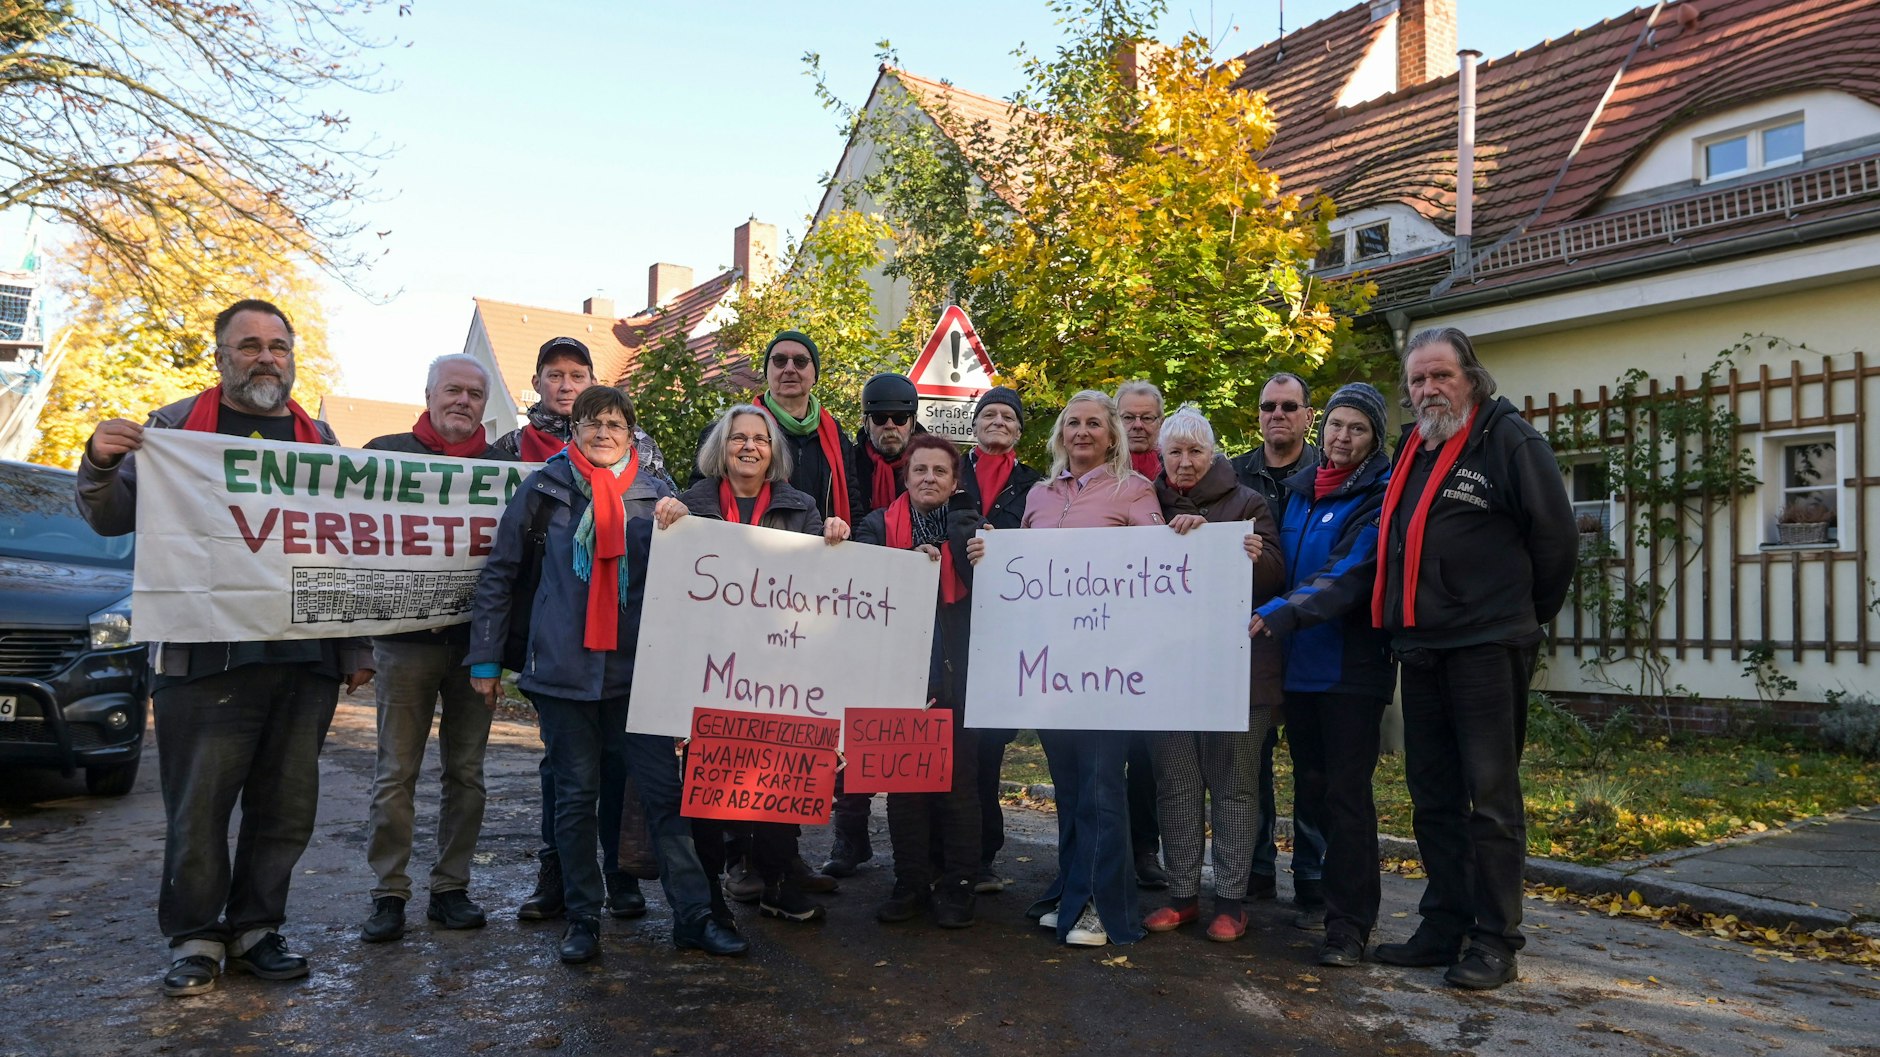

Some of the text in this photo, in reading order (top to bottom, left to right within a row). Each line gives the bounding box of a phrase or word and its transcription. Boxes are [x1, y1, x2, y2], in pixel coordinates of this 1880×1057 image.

[1457, 481, 1475, 493] AM
[687, 554, 897, 627] Solidarität
[999, 553, 1192, 602] Solidarität
[1073, 602, 1111, 631] mit
[767, 621, 806, 649] mit
[702, 651, 827, 716] Manne
[1018, 645, 1146, 697] Manne
[696, 713, 840, 747] GENTRIFIZIERUNG
[852, 716, 948, 744] SCHÄMT
[702, 743, 817, 775] WAHNSINN
[693, 766, 817, 794] ROTE KARTE
[688, 785, 825, 818] FÜR ABZOCKER
